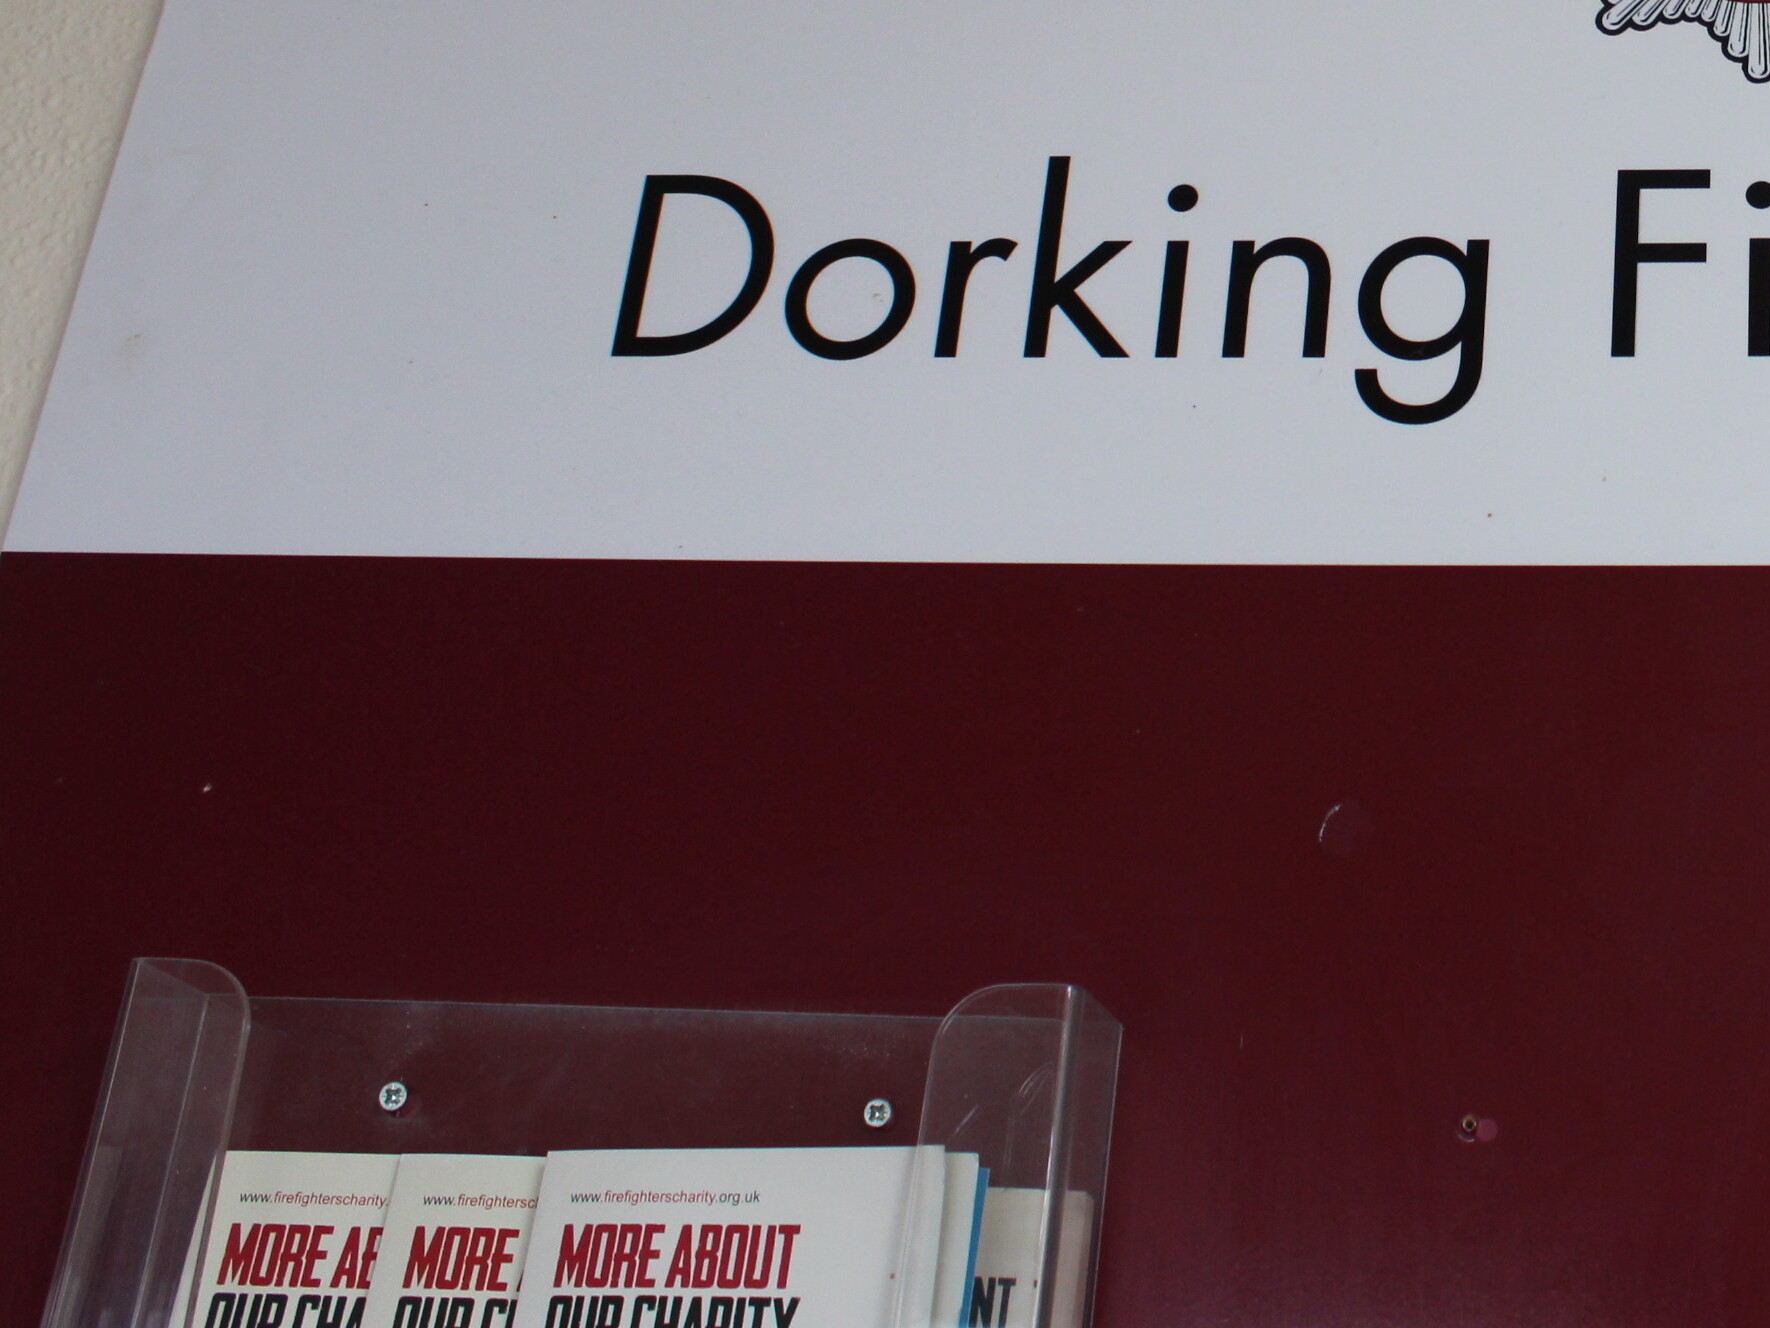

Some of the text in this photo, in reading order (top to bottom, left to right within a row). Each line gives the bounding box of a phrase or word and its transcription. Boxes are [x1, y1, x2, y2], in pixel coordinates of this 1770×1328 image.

[612, 156, 1489, 424] Dorking
[570, 1190, 761, 1207] www.firefighterscharity.org.uk
[217, 1223, 335, 1288] MORE
[402, 1226, 520, 1291] MORE
[553, 1224, 802, 1289] MORE ABOUT
